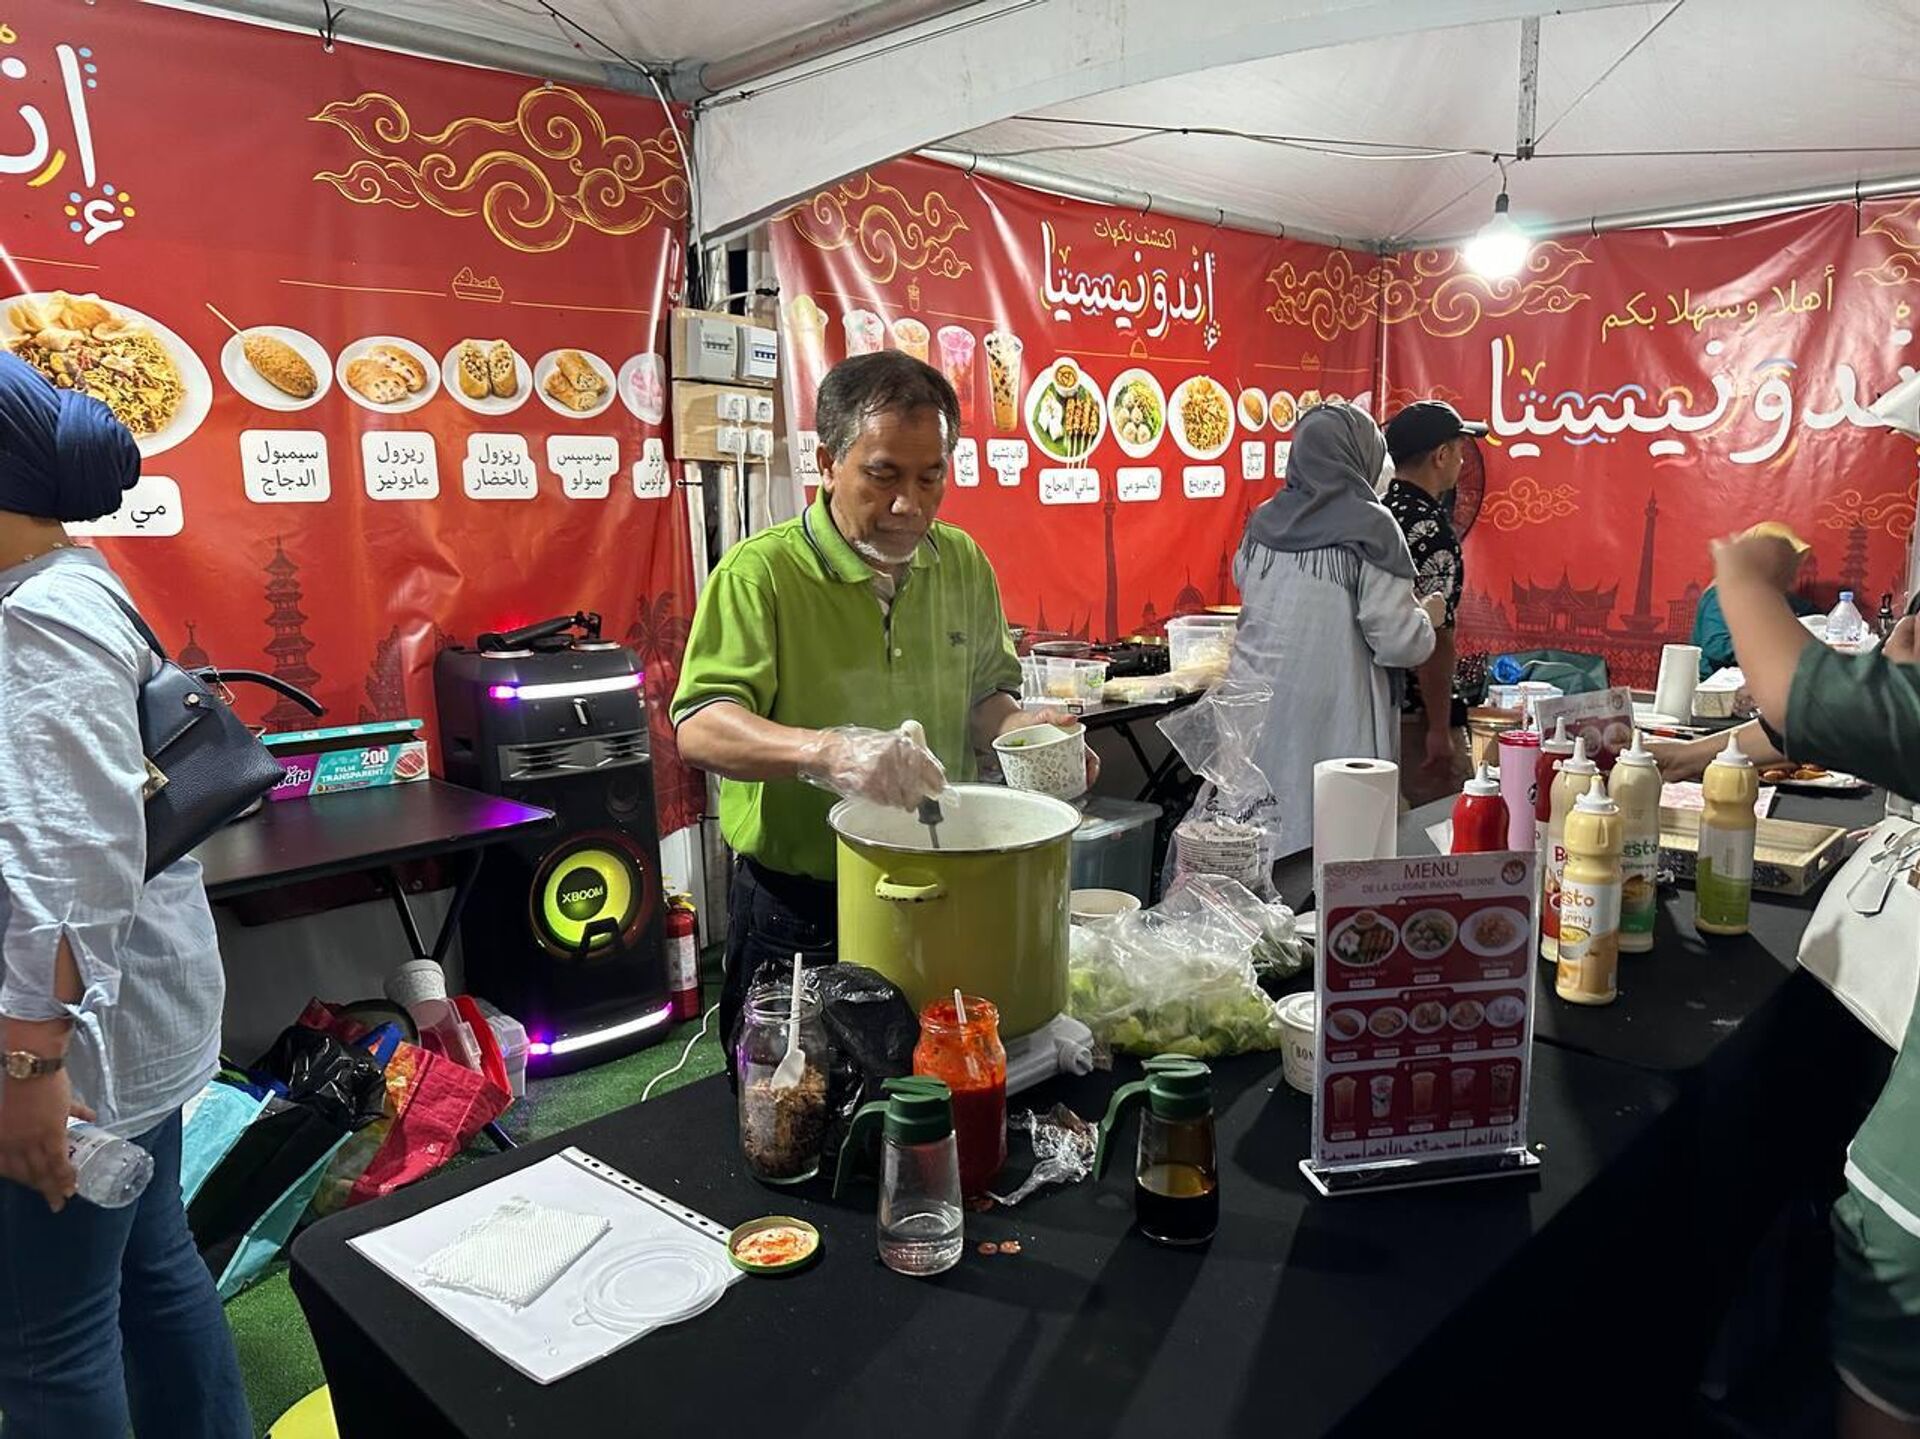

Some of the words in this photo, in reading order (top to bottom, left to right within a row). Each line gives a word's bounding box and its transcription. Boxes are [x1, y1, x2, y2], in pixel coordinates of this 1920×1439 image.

[1094, 218, 1133, 247] نكهات
[1134, 226, 1177, 249] اكتشف
[1771, 264, 1836, 316] أهلا
[1601, 291, 1657, 344] بكم
[1666, 288, 1759, 332] وسهلا
[256, 440, 319, 464] سيمبول
[376, 441, 425, 464] ريزول
[478, 442, 521, 465] ريزول
[261, 468, 317, 496] الدجاج
[376, 468, 429, 492] مايونيز
[473, 468, 529, 491] بالخضار
[571, 469, 602, 490] سولو
[131, 505, 166, 528] مي
[360, 750, 389, 765] 200
[321, 768, 384, 782] TRANSPARENT
[1404, 861, 1460, 879] MENU
[562, 886, 604, 904] XBOOM
